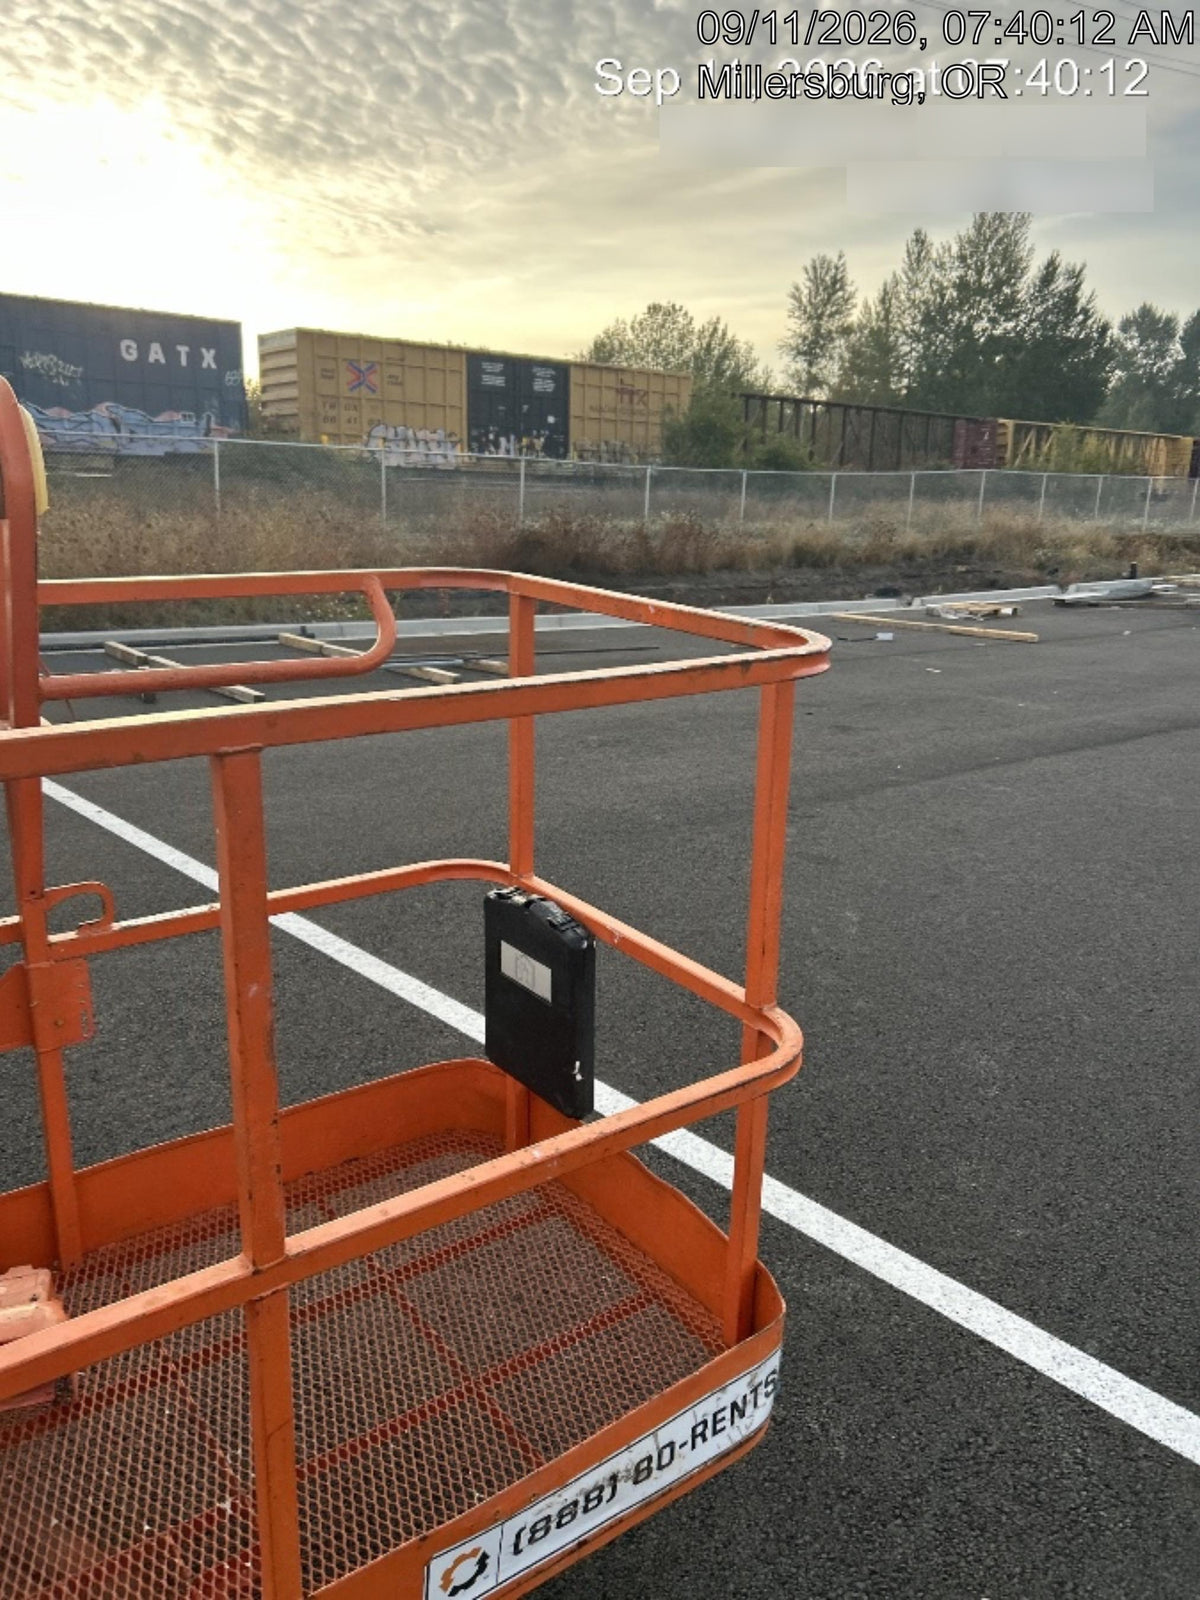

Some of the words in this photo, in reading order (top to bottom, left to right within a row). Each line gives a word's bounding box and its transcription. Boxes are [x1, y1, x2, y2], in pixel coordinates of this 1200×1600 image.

[120, 339, 217, 369] GATX
[512, 1472, 618, 1556] (888)
[633, 1368, 779, 1486] 80-RENTS
